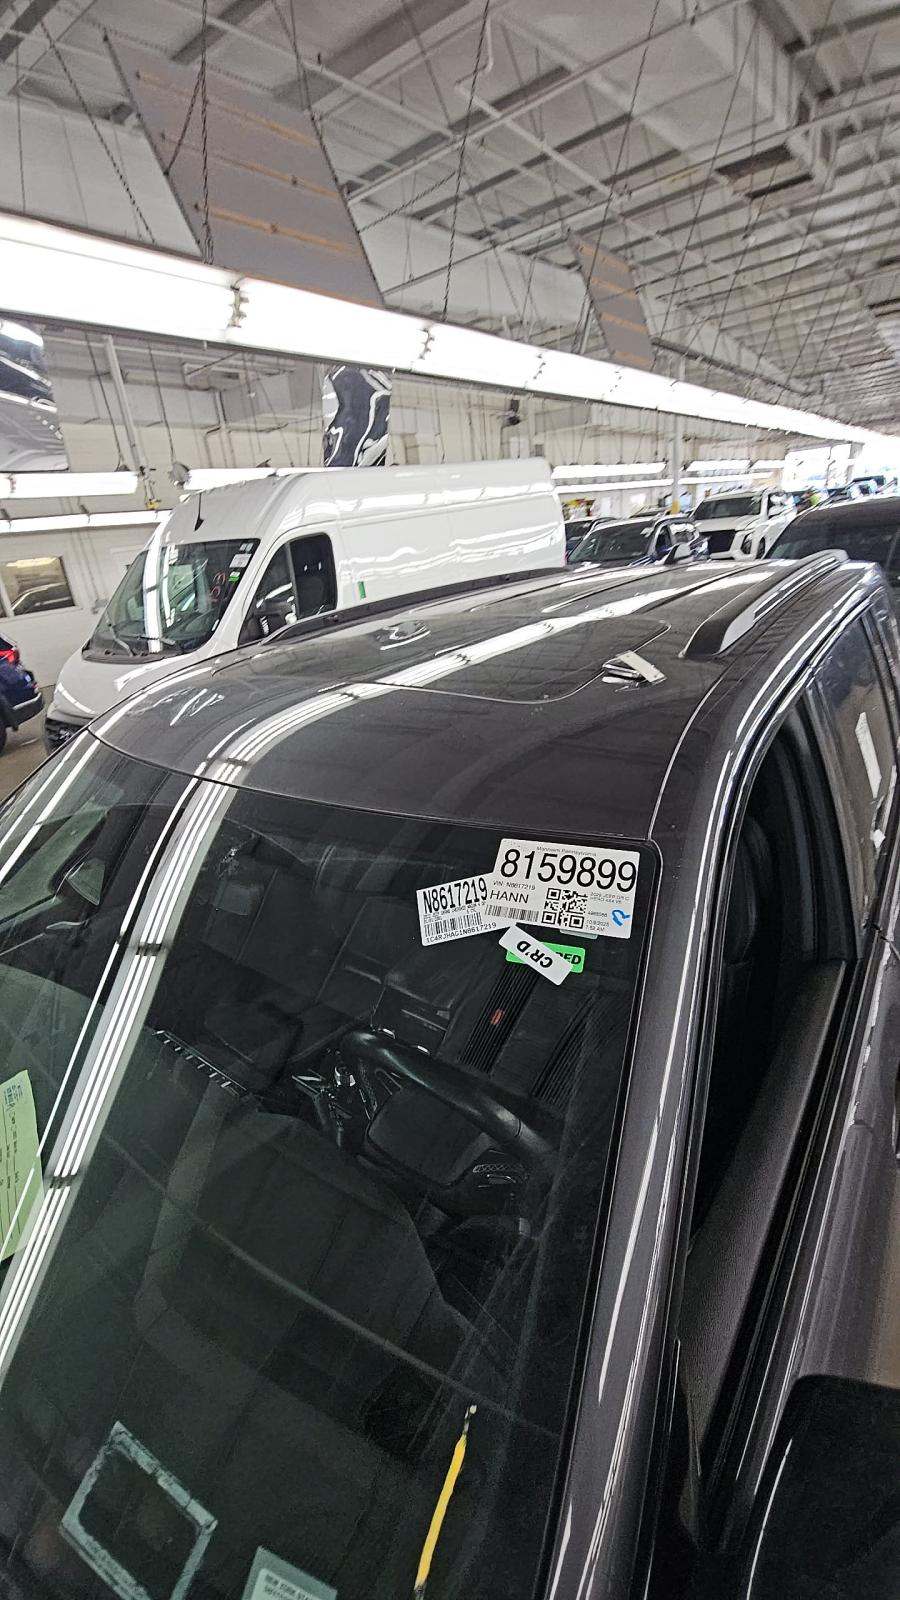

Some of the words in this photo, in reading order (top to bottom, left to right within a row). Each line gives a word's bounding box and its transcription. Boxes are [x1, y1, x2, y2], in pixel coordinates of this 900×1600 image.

[500, 848, 637, 893] 8159899
[422, 877, 488, 914] N8617219
[489, 889, 529, 904] HANN
